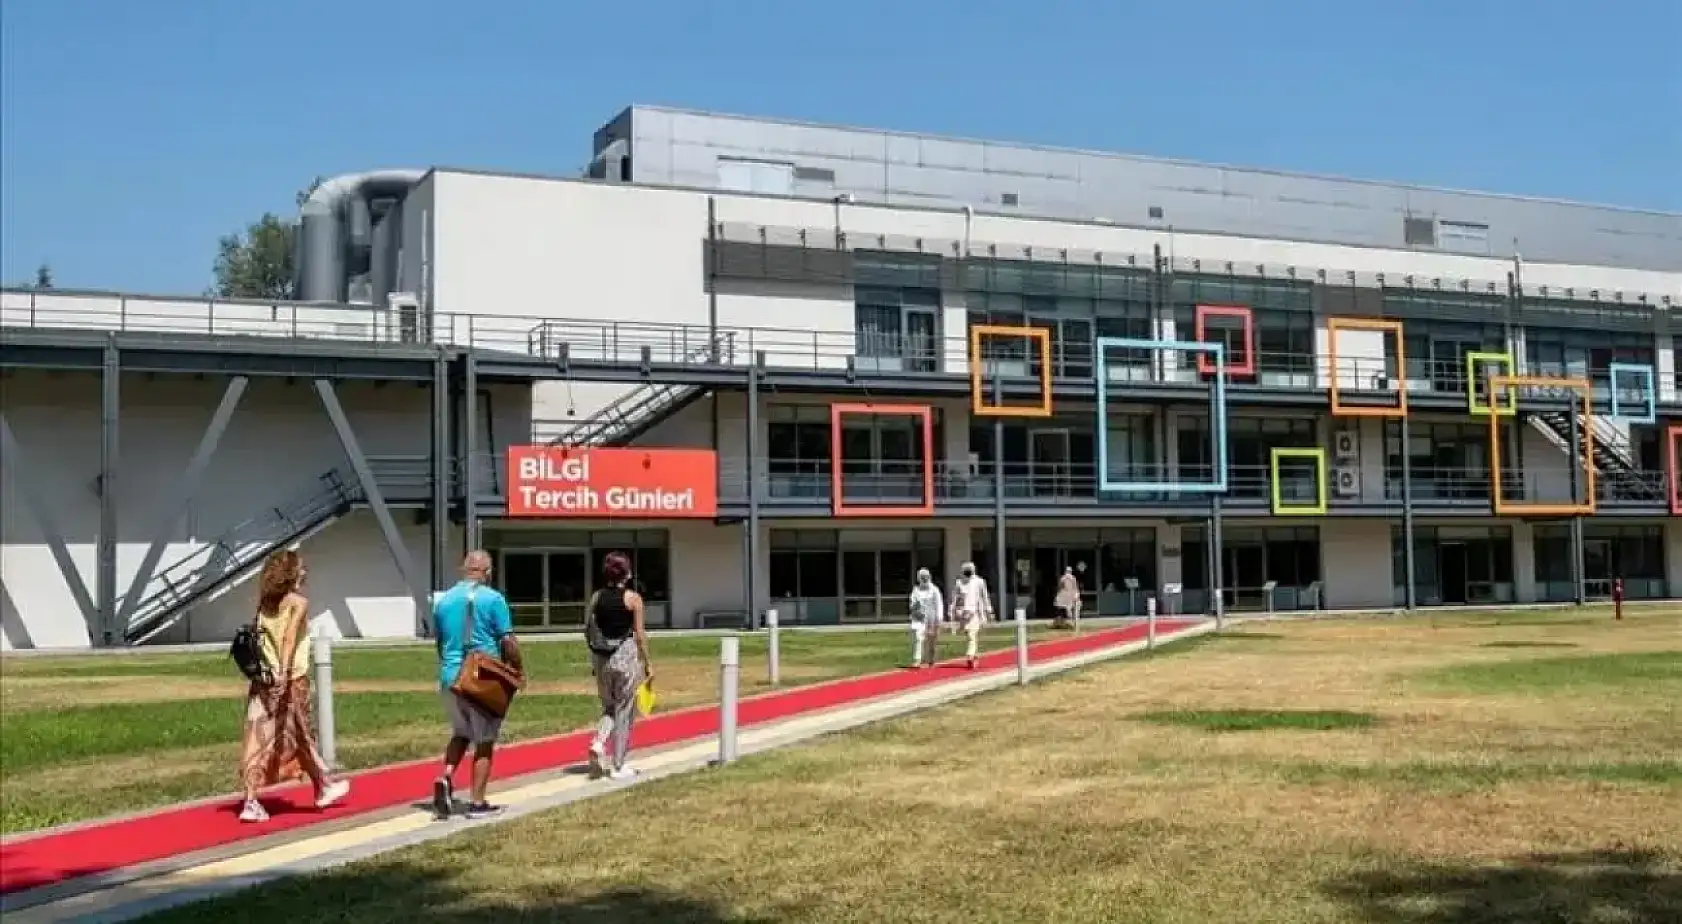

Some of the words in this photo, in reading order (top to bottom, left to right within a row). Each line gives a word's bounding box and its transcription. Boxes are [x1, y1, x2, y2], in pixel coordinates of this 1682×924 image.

[519, 453, 589, 481] BİLGİ
[518, 485, 599, 509] Tercih
[605, 486, 693, 510] Günleri
